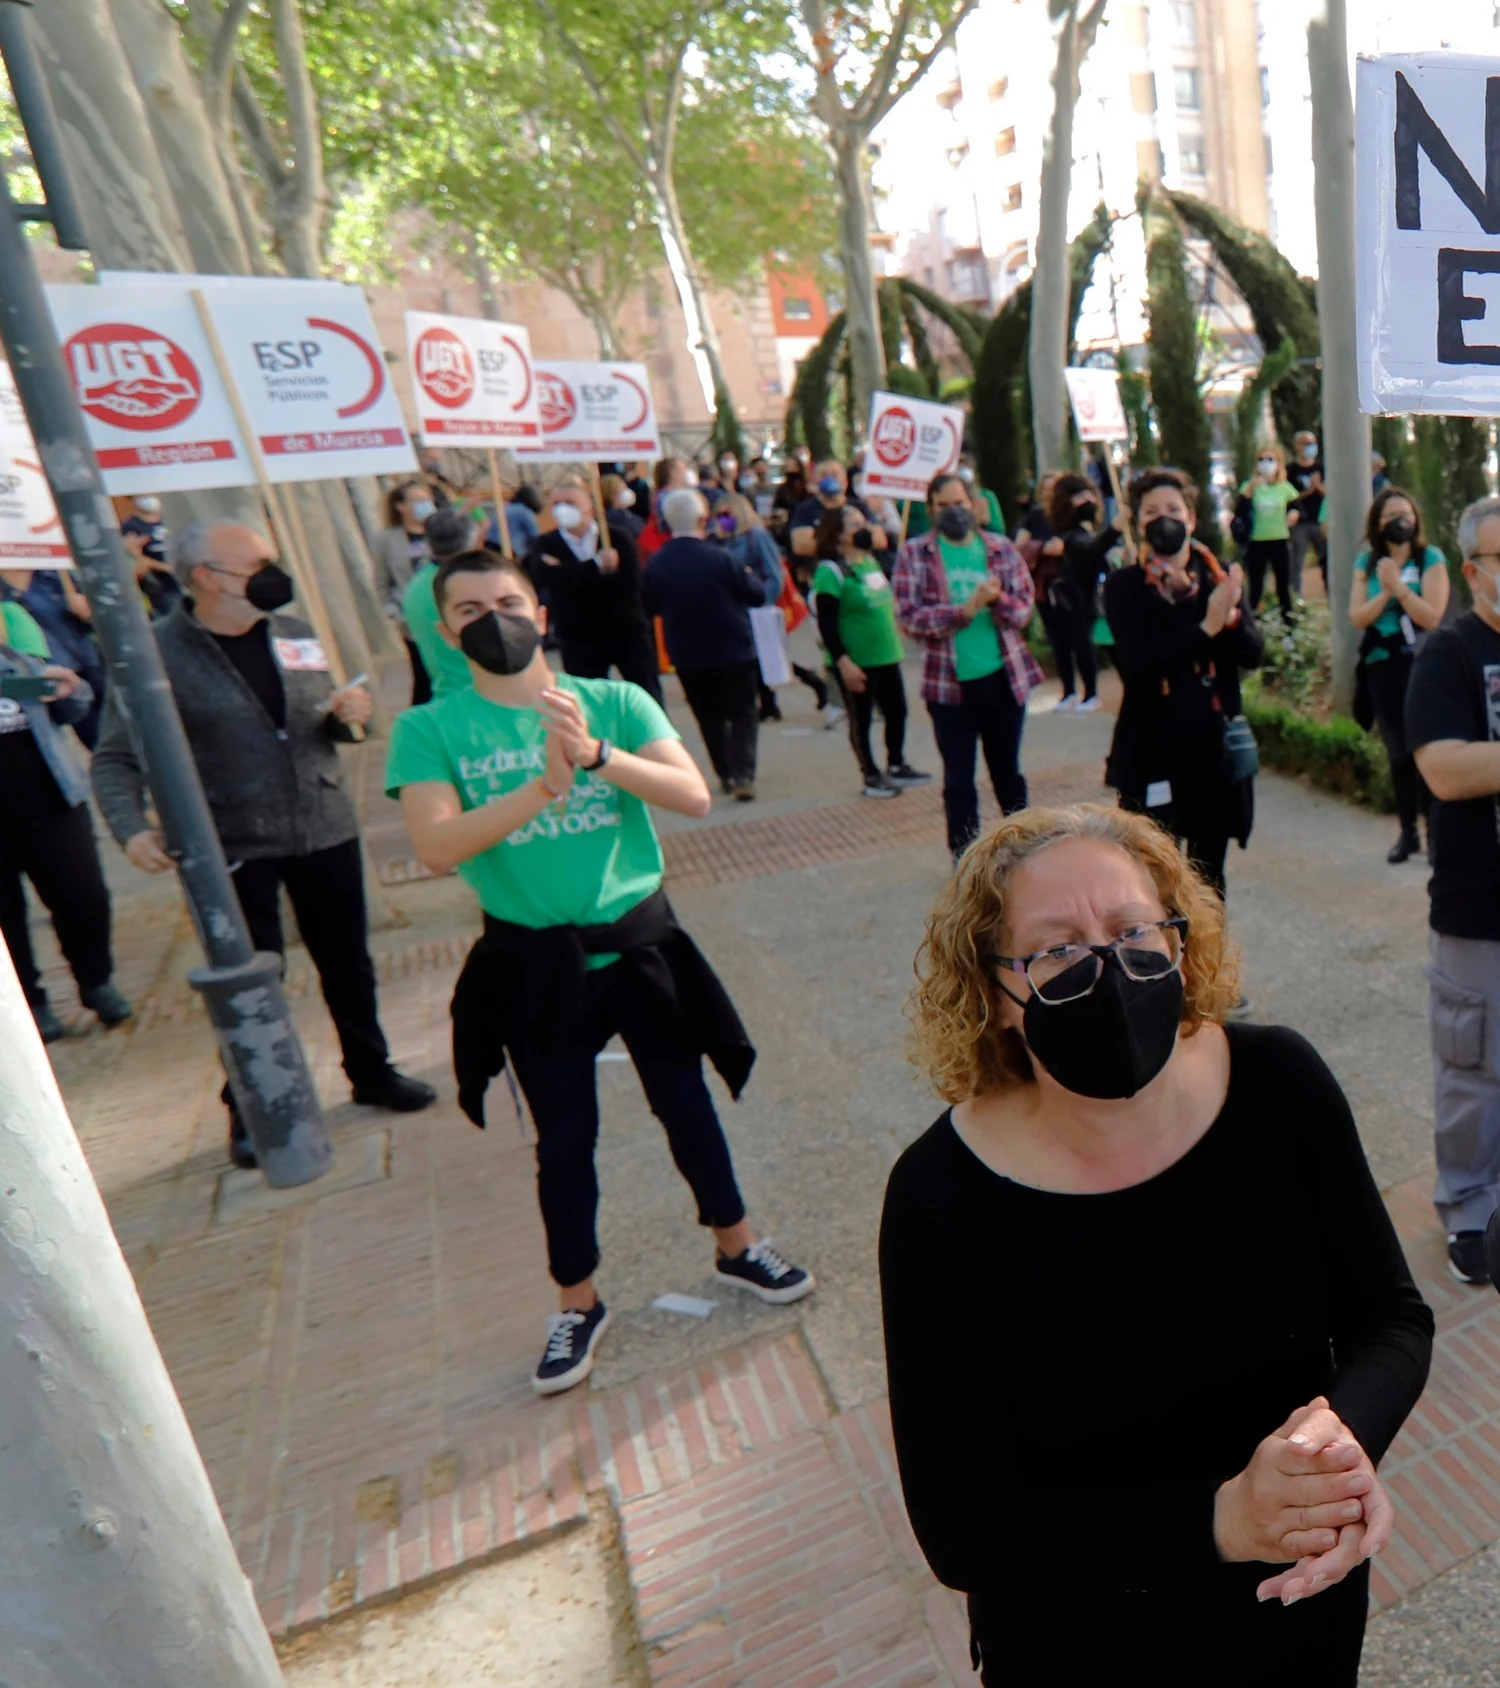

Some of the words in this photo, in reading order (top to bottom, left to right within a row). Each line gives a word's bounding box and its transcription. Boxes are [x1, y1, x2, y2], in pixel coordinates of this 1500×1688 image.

[72, 339, 180, 387] UGT
[420, 340, 468, 376] UGT
[281, 433, 310, 451] de
[313, 429, 386, 449] Murcia
